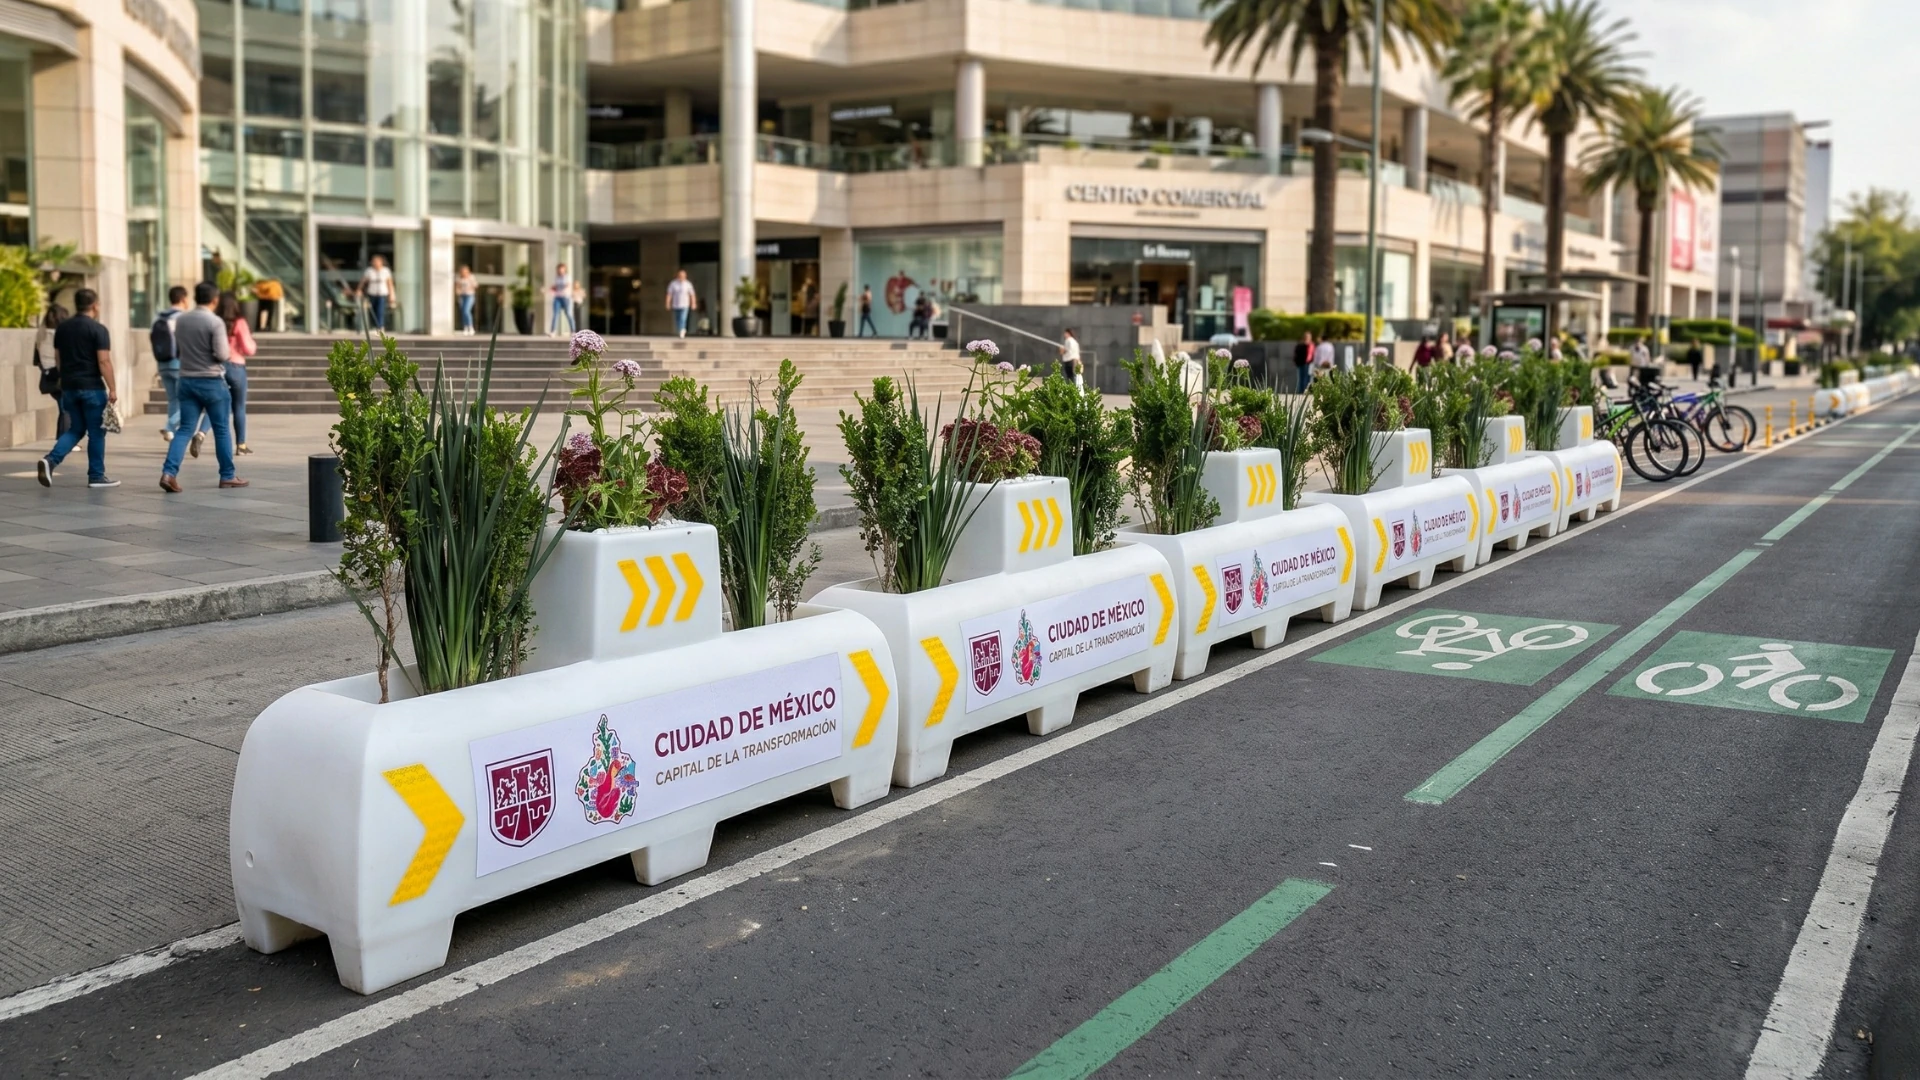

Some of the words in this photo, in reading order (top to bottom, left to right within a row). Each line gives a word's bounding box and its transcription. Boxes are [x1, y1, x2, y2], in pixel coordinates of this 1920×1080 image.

[1065, 184, 1149, 206] CENTRO
[1151, 187, 1266, 210] COMERCIAL
[1271, 556, 1299, 577] CIUDAD
[1299, 553, 1310, 569] DE
[1310, 546, 1336, 566] MÉXICO
[1048, 615, 1090, 643] CIUDAD
[1091, 609, 1106, 630] DE
[1107, 598, 1145, 625] MÉXICO
[1048, 646, 1076, 663] CAPITAL
[1075, 642, 1085, 655] DE
[1085, 639, 1094, 652] LA
[654, 715, 734, 758] CIUDAD
[739, 706, 764, 735] DE
[769, 687, 836, 726] MÉXICO
[655, 760, 705, 786] CAPITAL
[707, 753, 723, 770] DE
[725, 749, 740, 765] LA
[742, 718, 837, 759] TRANSFORMACIÓN
